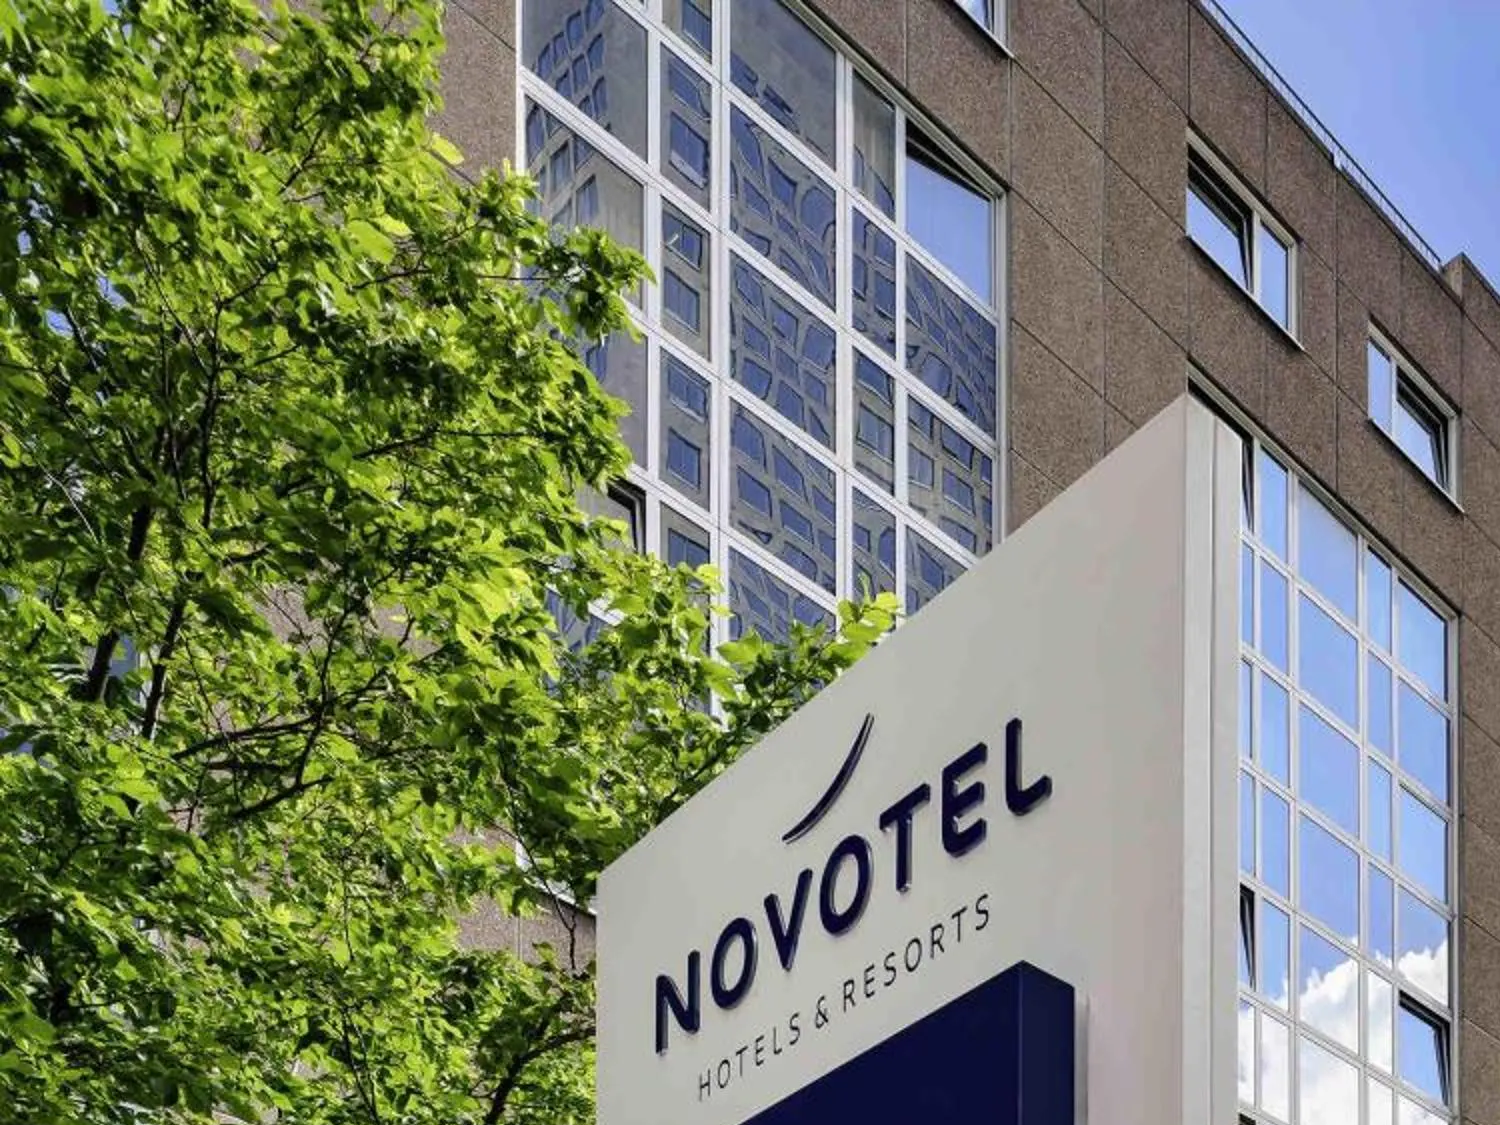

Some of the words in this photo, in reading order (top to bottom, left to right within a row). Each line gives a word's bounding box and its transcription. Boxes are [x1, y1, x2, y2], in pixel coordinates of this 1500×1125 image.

[655, 717, 1053, 1056] NOVOTEL
[698, 1012, 801, 1102] HOTELS
[814, 995, 830, 1030] &
[843, 893, 990, 1013] RESORTS
